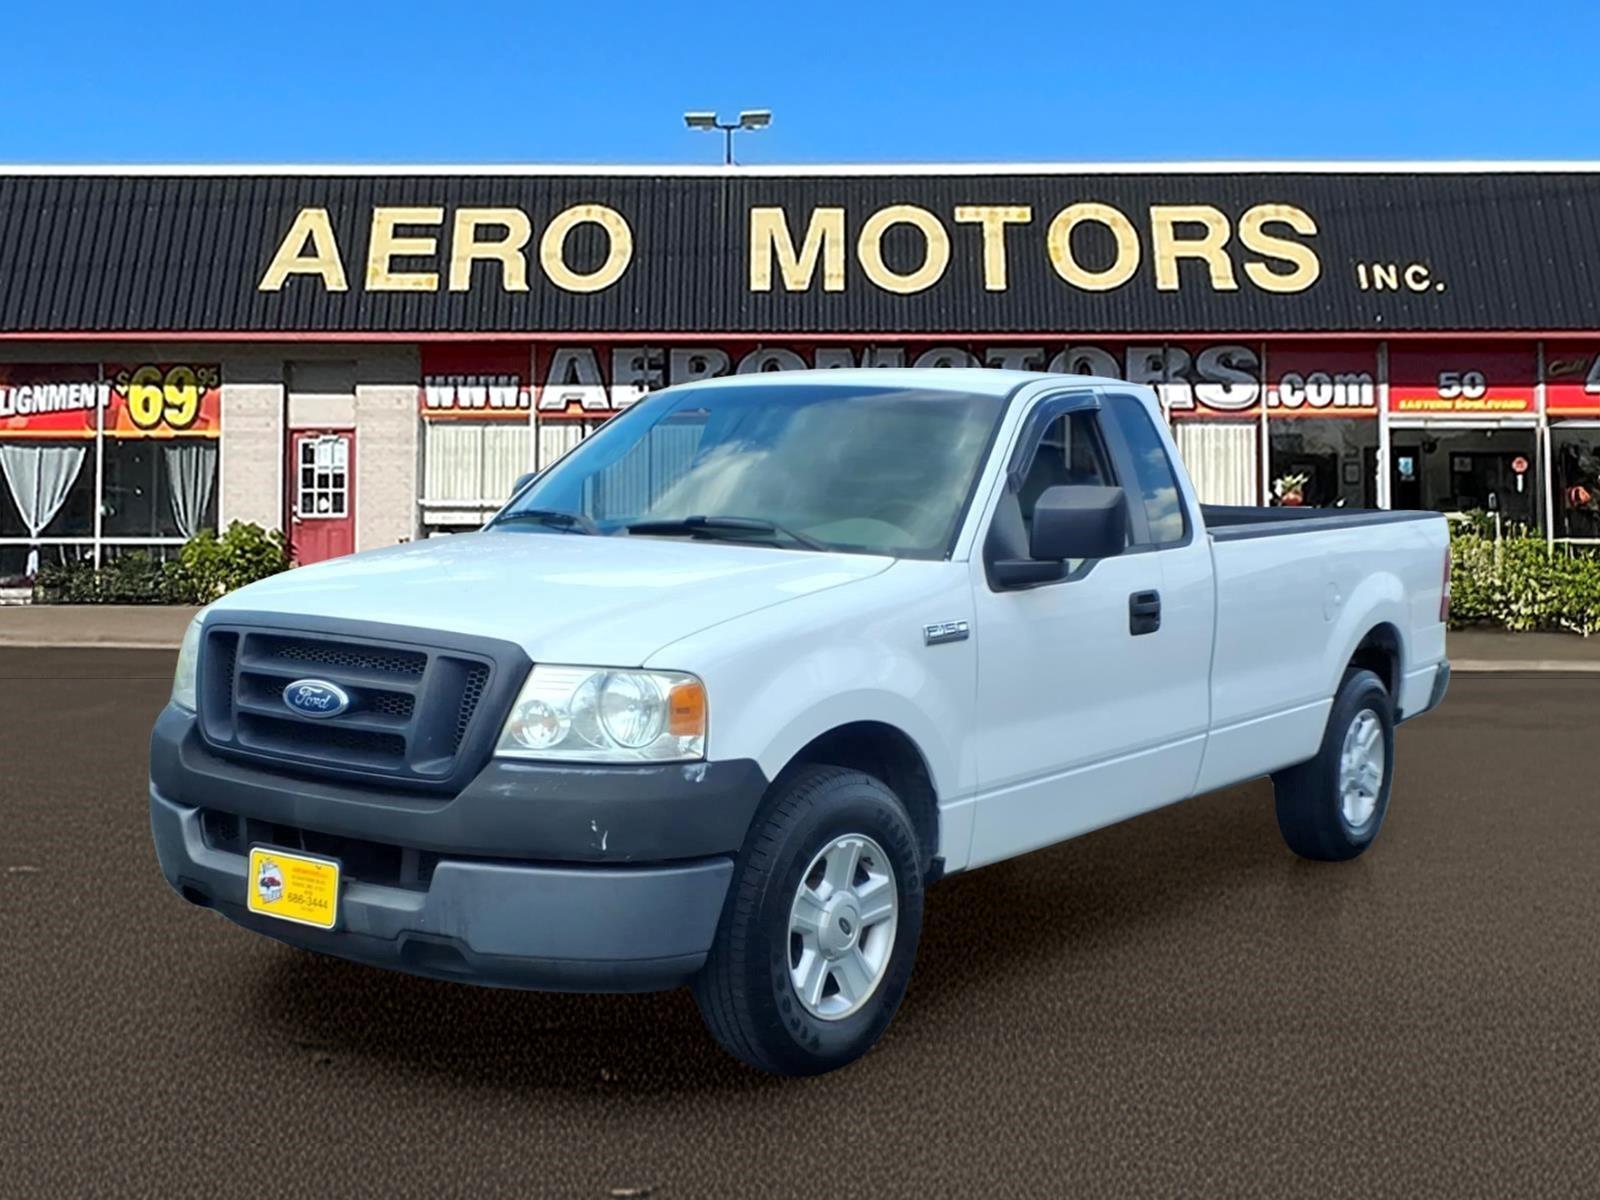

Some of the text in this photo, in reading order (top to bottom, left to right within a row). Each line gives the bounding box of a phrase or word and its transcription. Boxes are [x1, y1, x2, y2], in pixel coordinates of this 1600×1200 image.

[257, 202, 1445, 294] AERO MOTORS INC.
[1437, 371, 1486, 399] 50
[1454, 400, 1528, 411] BOULEVARD
[294, 685, 332, 709] Ford
